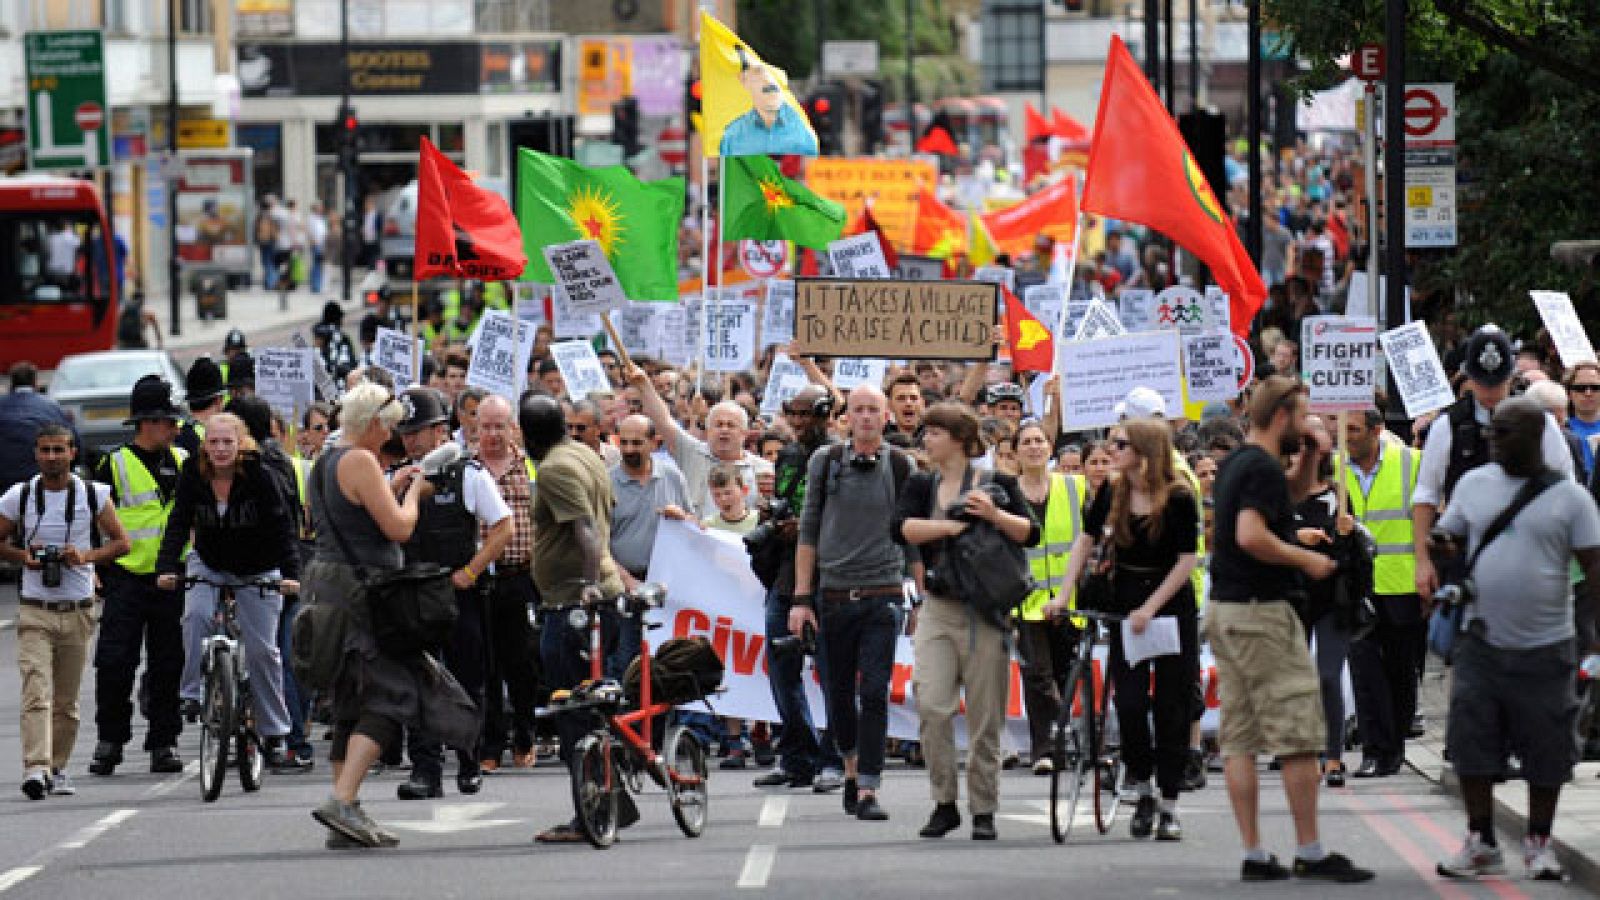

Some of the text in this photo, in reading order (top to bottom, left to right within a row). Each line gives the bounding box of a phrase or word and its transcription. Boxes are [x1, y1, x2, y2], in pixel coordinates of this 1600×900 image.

[1362, 47, 1380, 75] E
[834, 285, 899, 314] TAKES
[902, 287, 914, 314] A
[919, 287, 989, 316] VILLAGE
[801, 314, 991, 347] TO RAISE A CHILD
[1313, 342, 1374, 360] FIGHT
[1312, 369, 1373, 387] CUTS!
[673, 608, 769, 676] Giv
